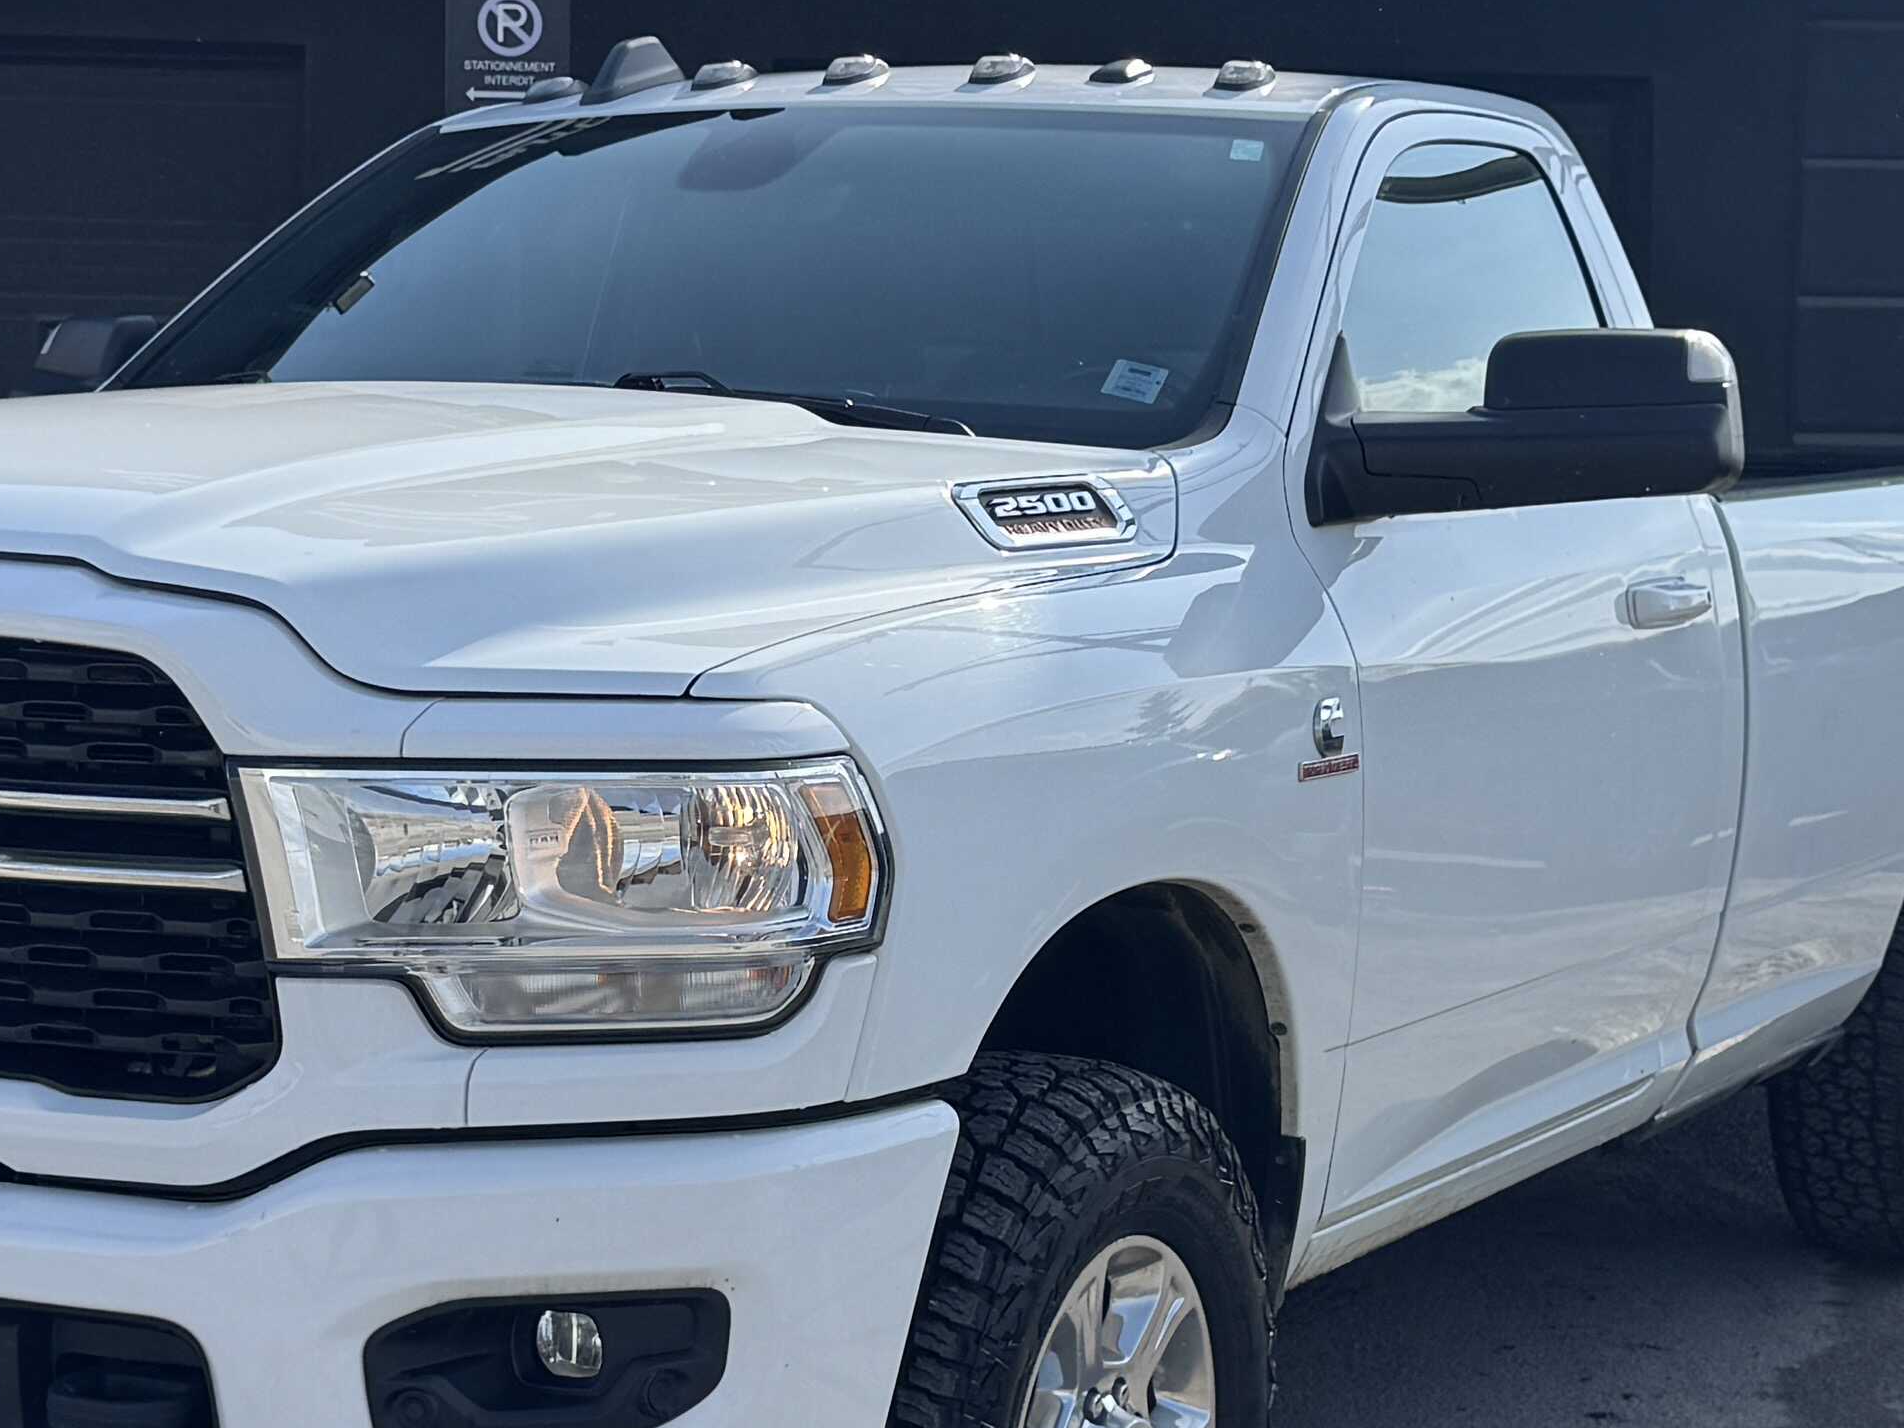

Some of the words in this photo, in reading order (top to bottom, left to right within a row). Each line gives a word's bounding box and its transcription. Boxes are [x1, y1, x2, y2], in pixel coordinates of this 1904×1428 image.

[463, 59, 556, 73] STATIONNEMENT
[484, 74, 536, 87] INTERDIT
[988, 490, 1096, 518] 2500
